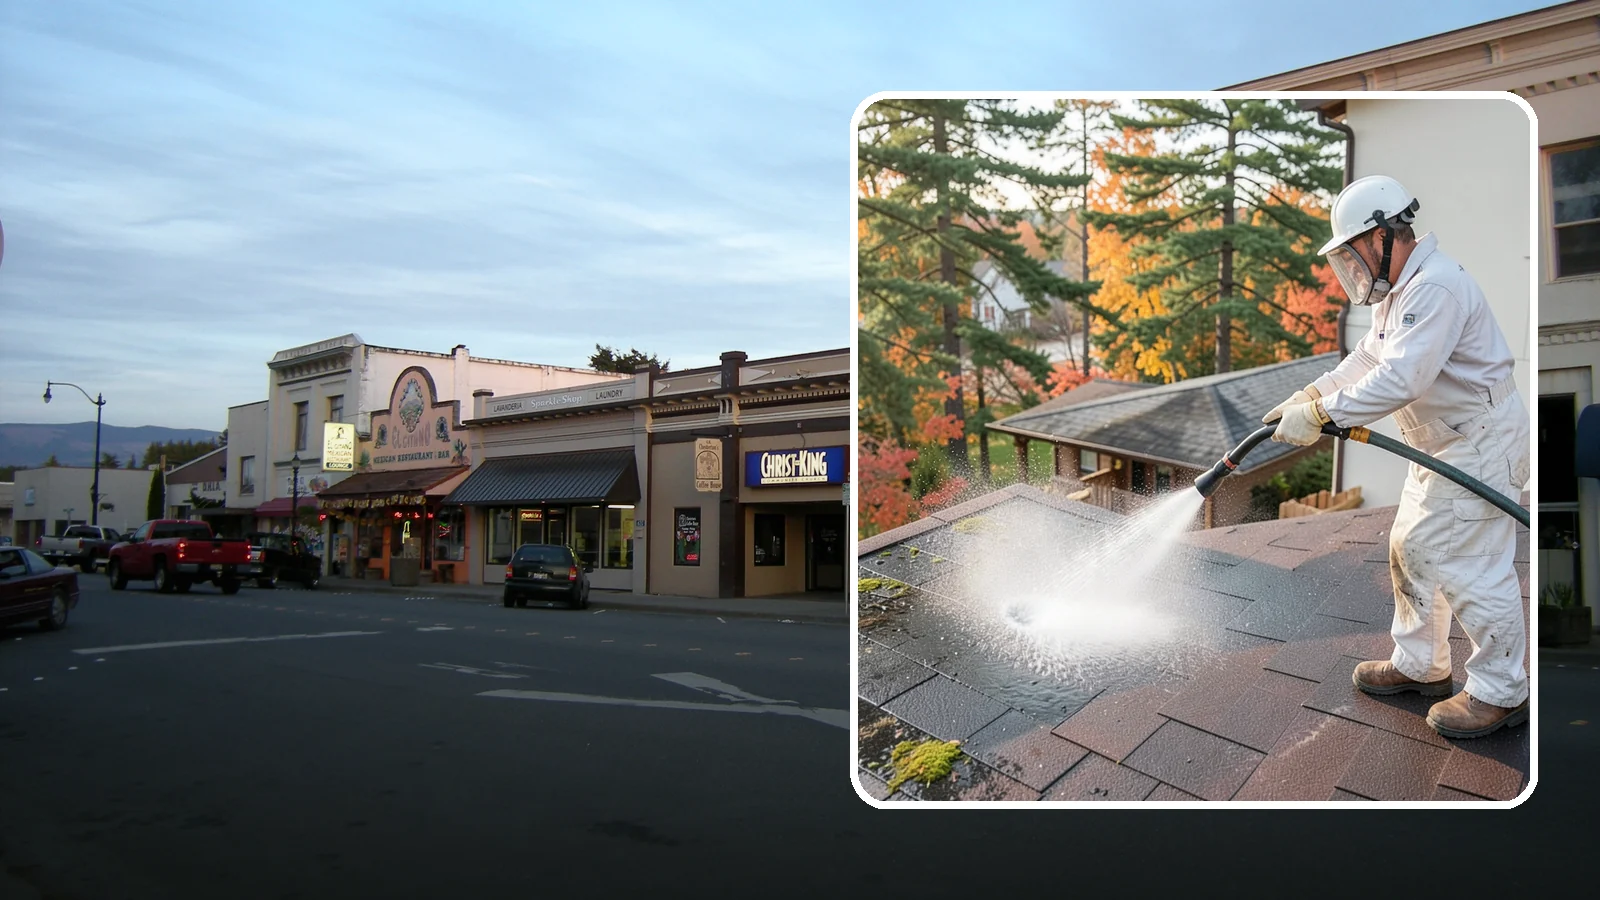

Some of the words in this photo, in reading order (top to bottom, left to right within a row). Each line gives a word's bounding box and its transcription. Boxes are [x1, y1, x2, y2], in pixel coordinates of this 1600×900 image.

[562, 394, 582, 404] Shop
[596, 389, 624, 400] LAUNDRY
[494, 402, 522, 412] LAVANDERIA
[374, 455, 396, 464] MEXICAN
[398, 452, 433, 462] RESTAURANT
[438, 450, 450, 458] BAR
[761, 452, 797, 478] CHRIST
[799, 450, 827, 476] KING
